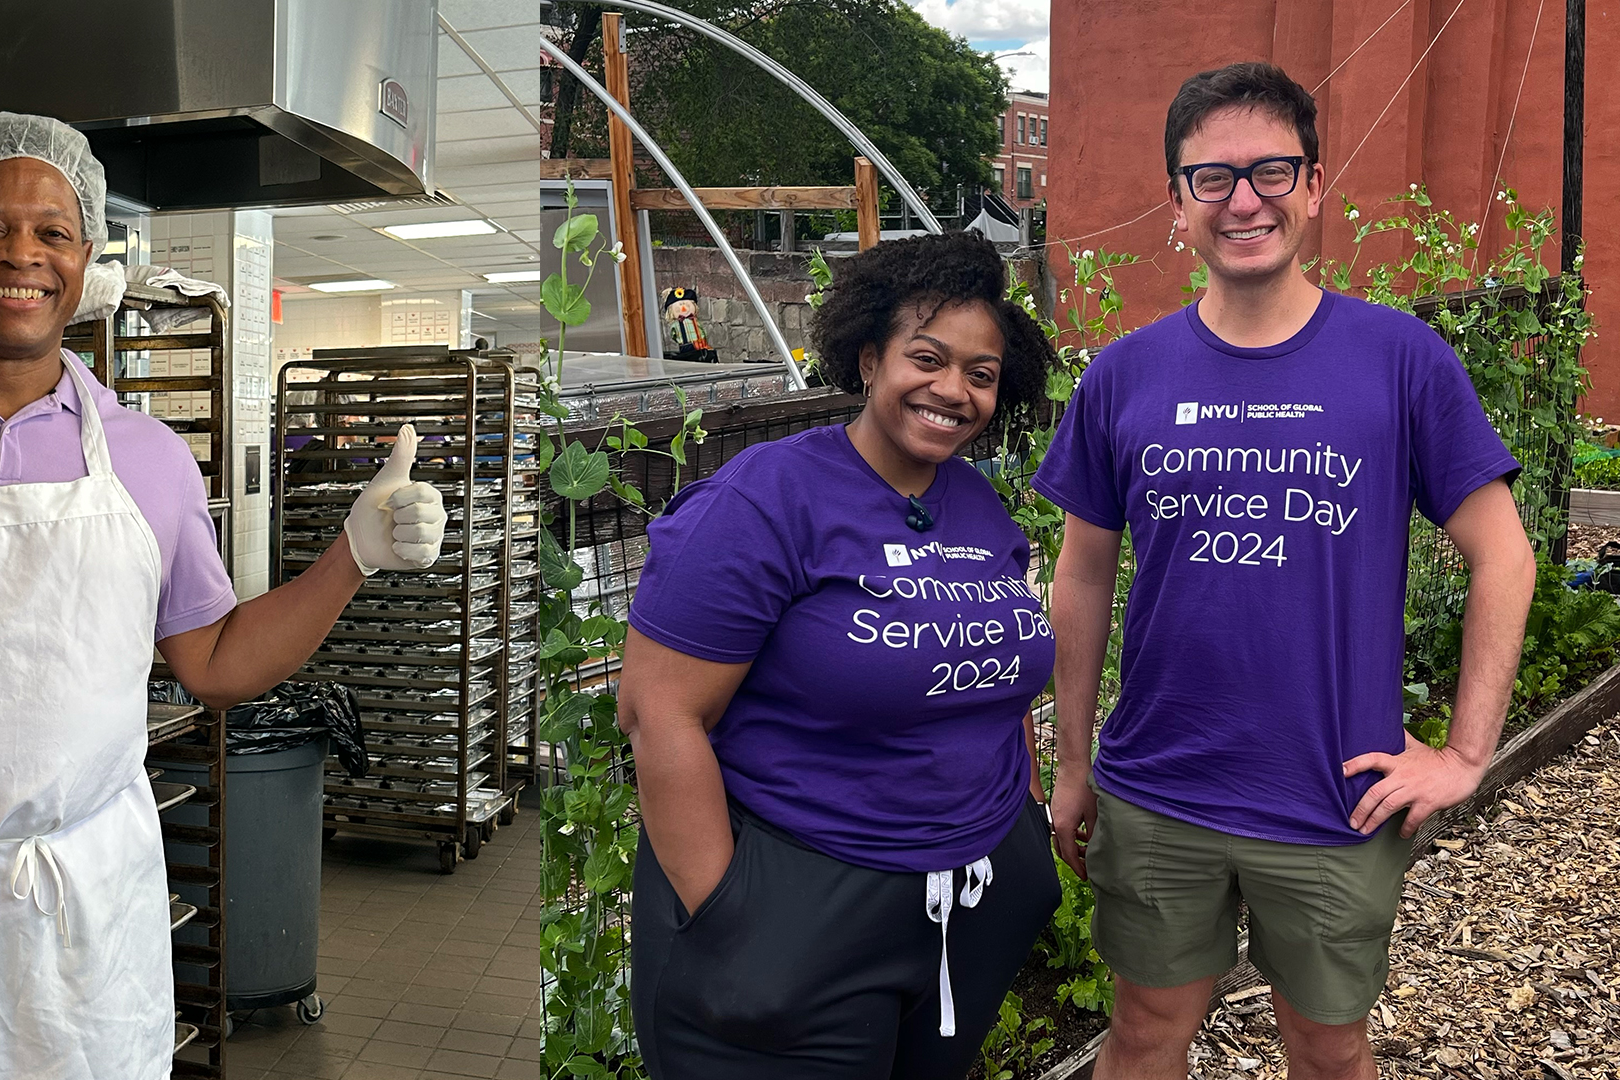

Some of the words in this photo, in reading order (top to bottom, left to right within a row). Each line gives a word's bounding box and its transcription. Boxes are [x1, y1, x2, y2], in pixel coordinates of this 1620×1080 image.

[1201, 404, 1239, 419] NYU
[1247, 404, 1279, 412] SCHOOL
[1280, 403, 1292, 411] OF
[1292, 403, 1324, 413] GLOBAL
[1247, 411, 1275, 419] PUBLIC
[1275, 411, 1305, 419] HEALTH
[1141, 442, 1362, 487] Community
[1146, 485, 1268, 520] Service
[1284, 488, 1358, 535] Day
[1189, 530, 1288, 567] 2024
[847, 608, 1005, 648] Service
[926, 655, 1020, 697] 2024
